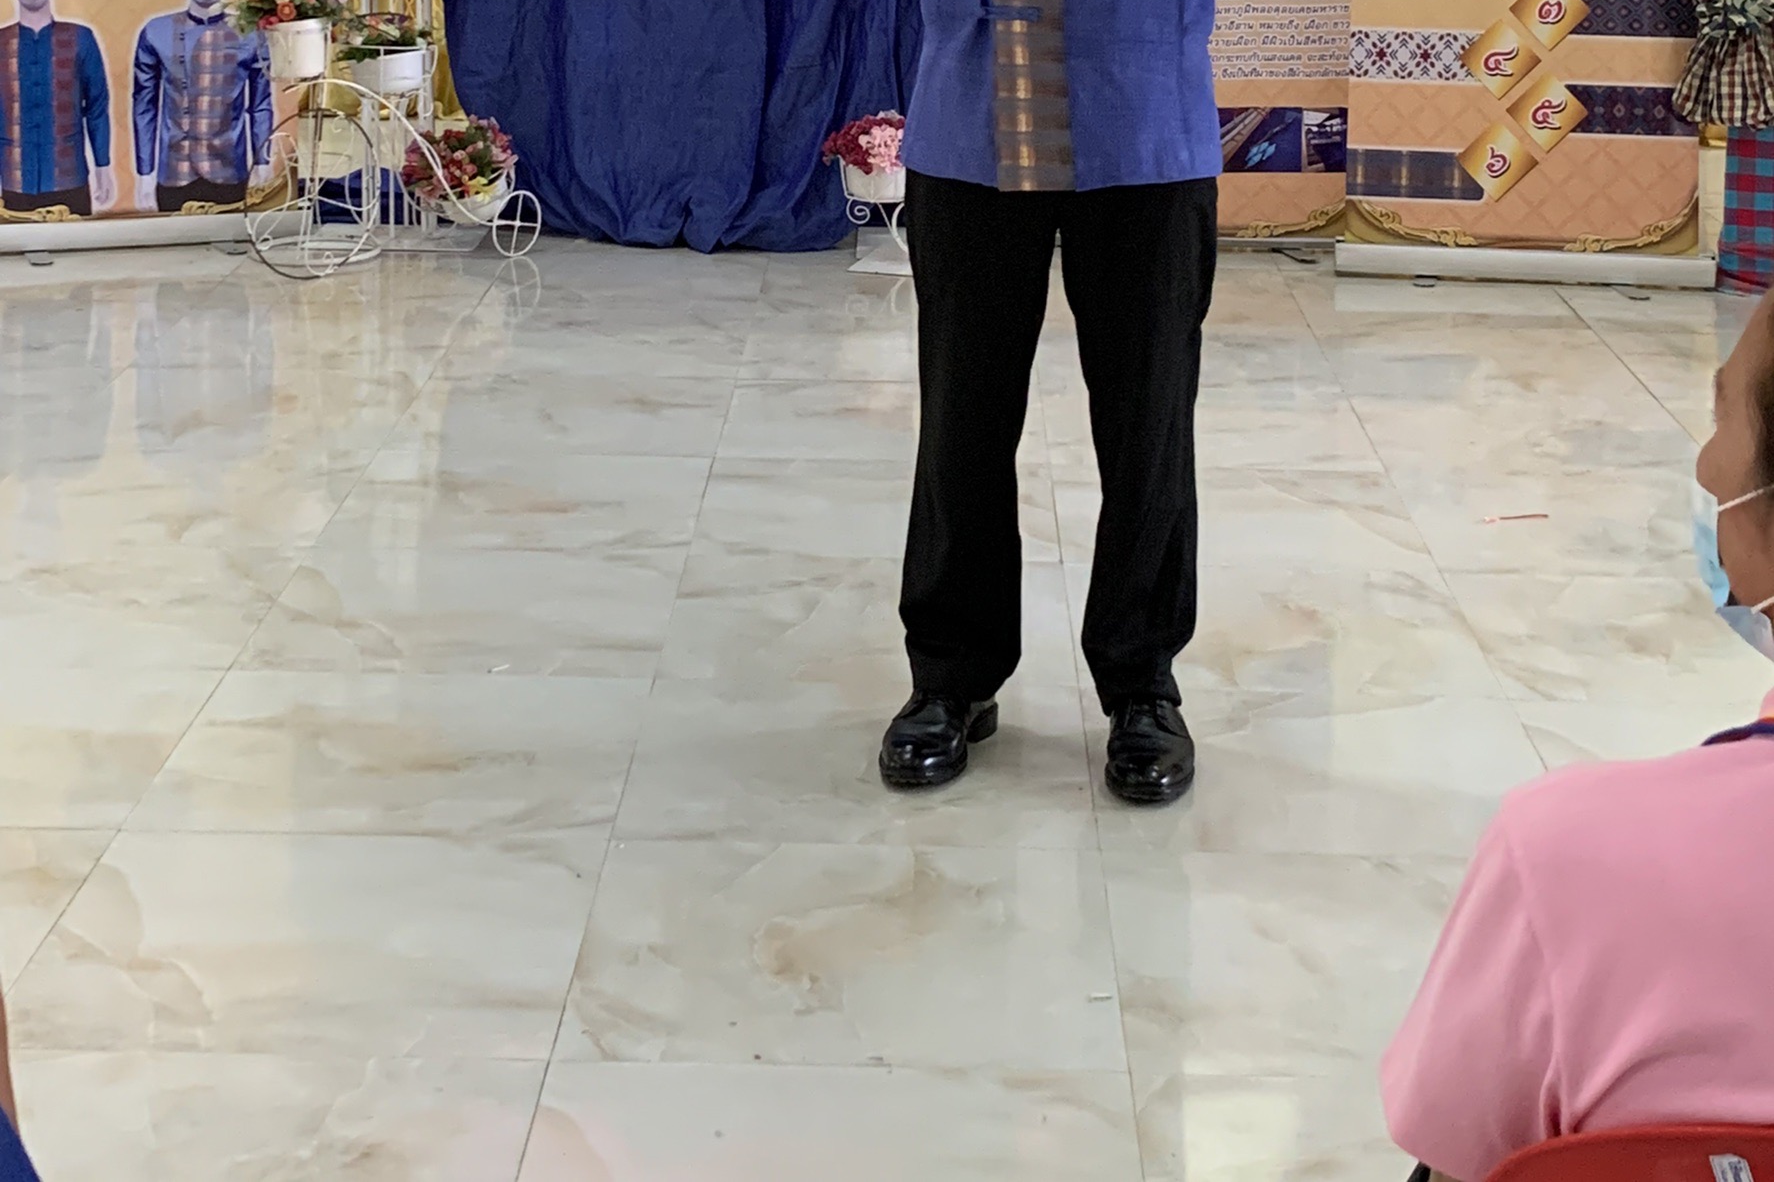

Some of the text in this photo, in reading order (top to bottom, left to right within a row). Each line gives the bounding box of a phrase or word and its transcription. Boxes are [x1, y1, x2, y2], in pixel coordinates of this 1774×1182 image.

[1482, 46, 1520, 77] ๔
[1530, 98, 1567, 130] ๕
[1484, 146, 1511, 178] ๖
